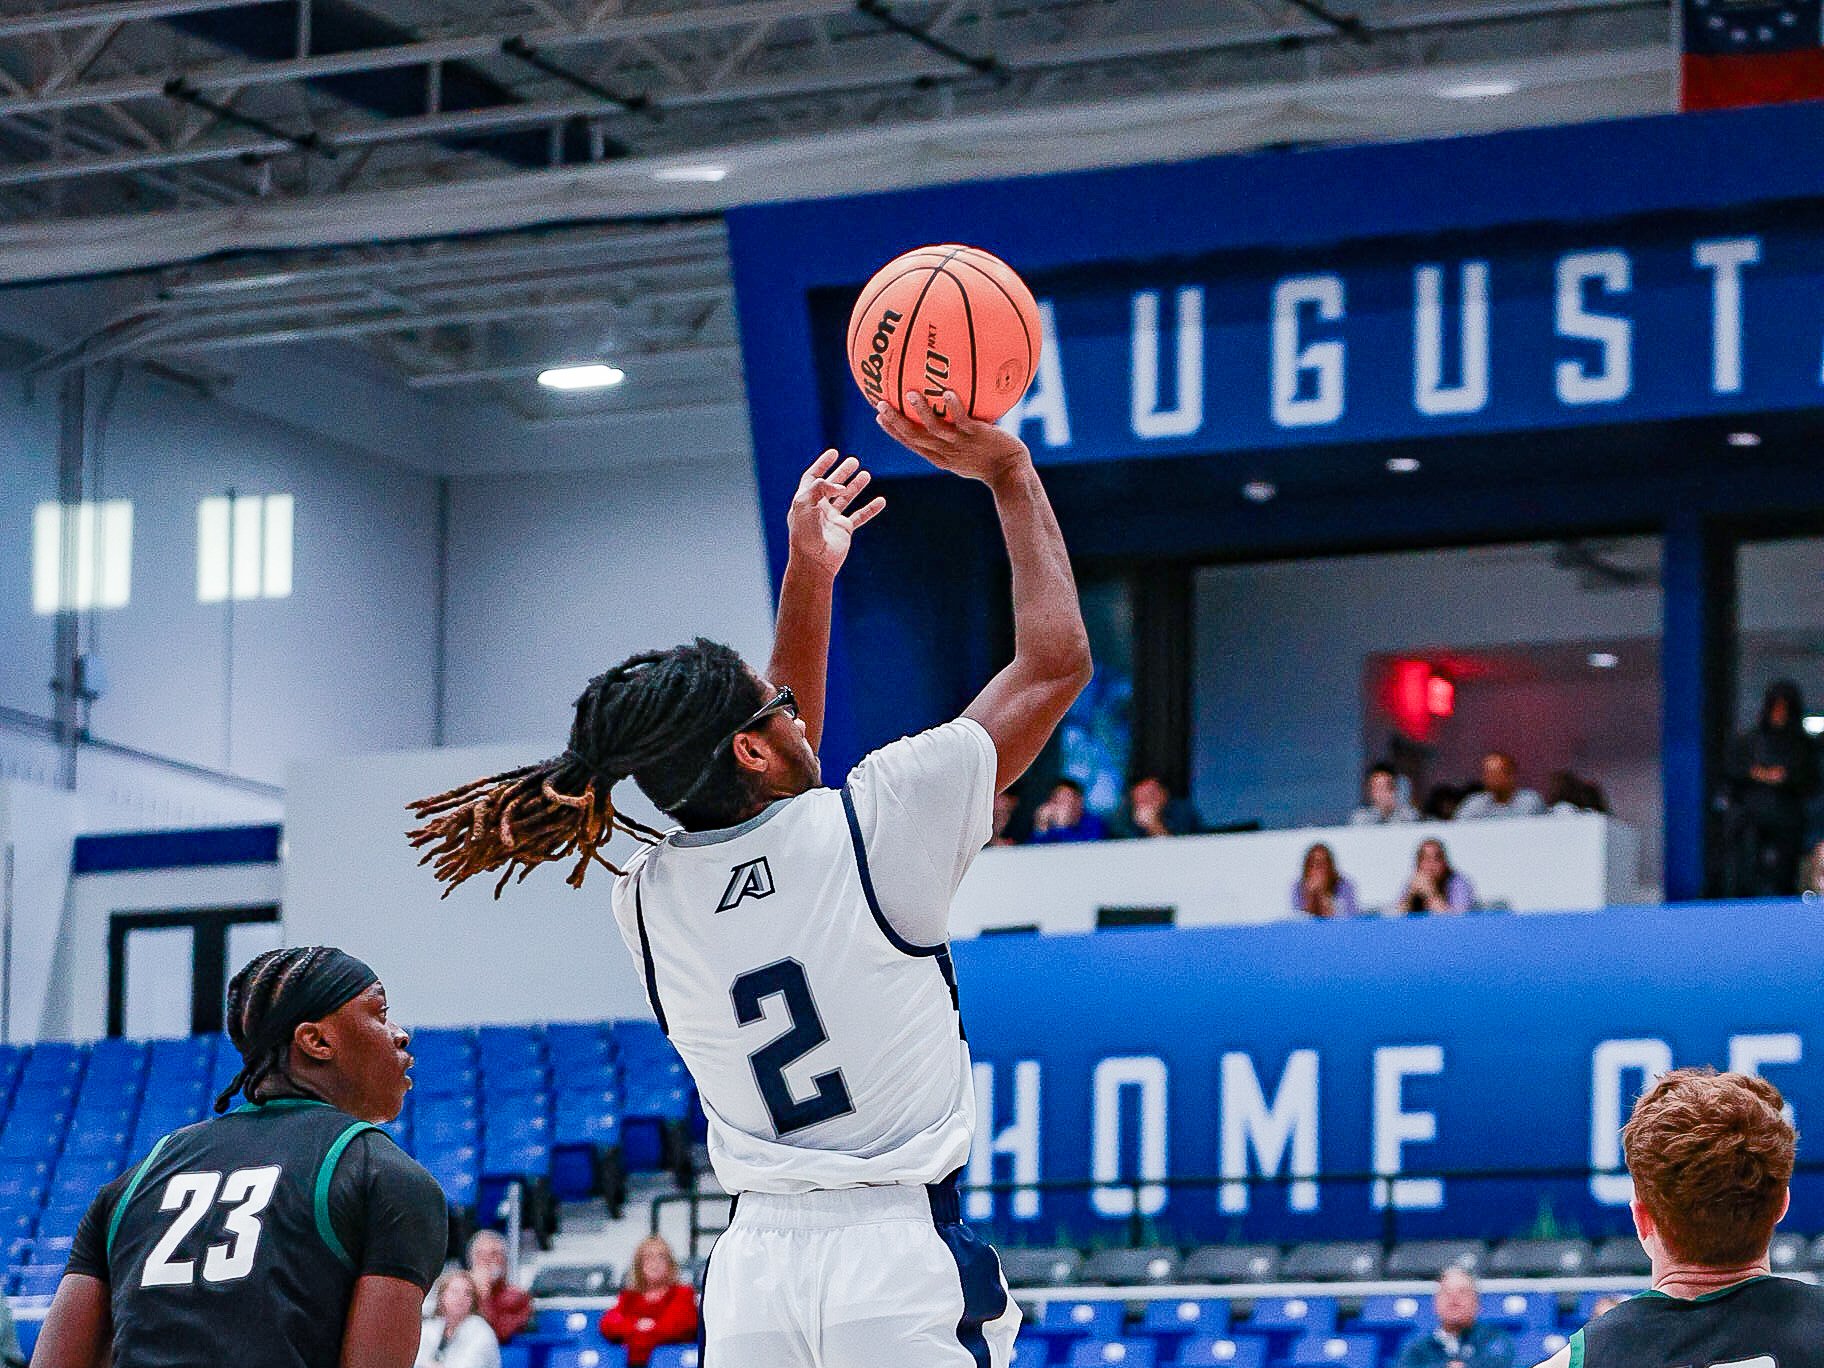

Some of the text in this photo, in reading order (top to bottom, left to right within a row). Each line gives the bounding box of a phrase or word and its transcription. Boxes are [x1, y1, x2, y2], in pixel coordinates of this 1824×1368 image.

[997, 237, 1824, 447] AUGUST
[729, 956, 857, 1139] 2
[966, 1043, 1446, 1220] HOME
[139, 1164, 283, 1289] 23
